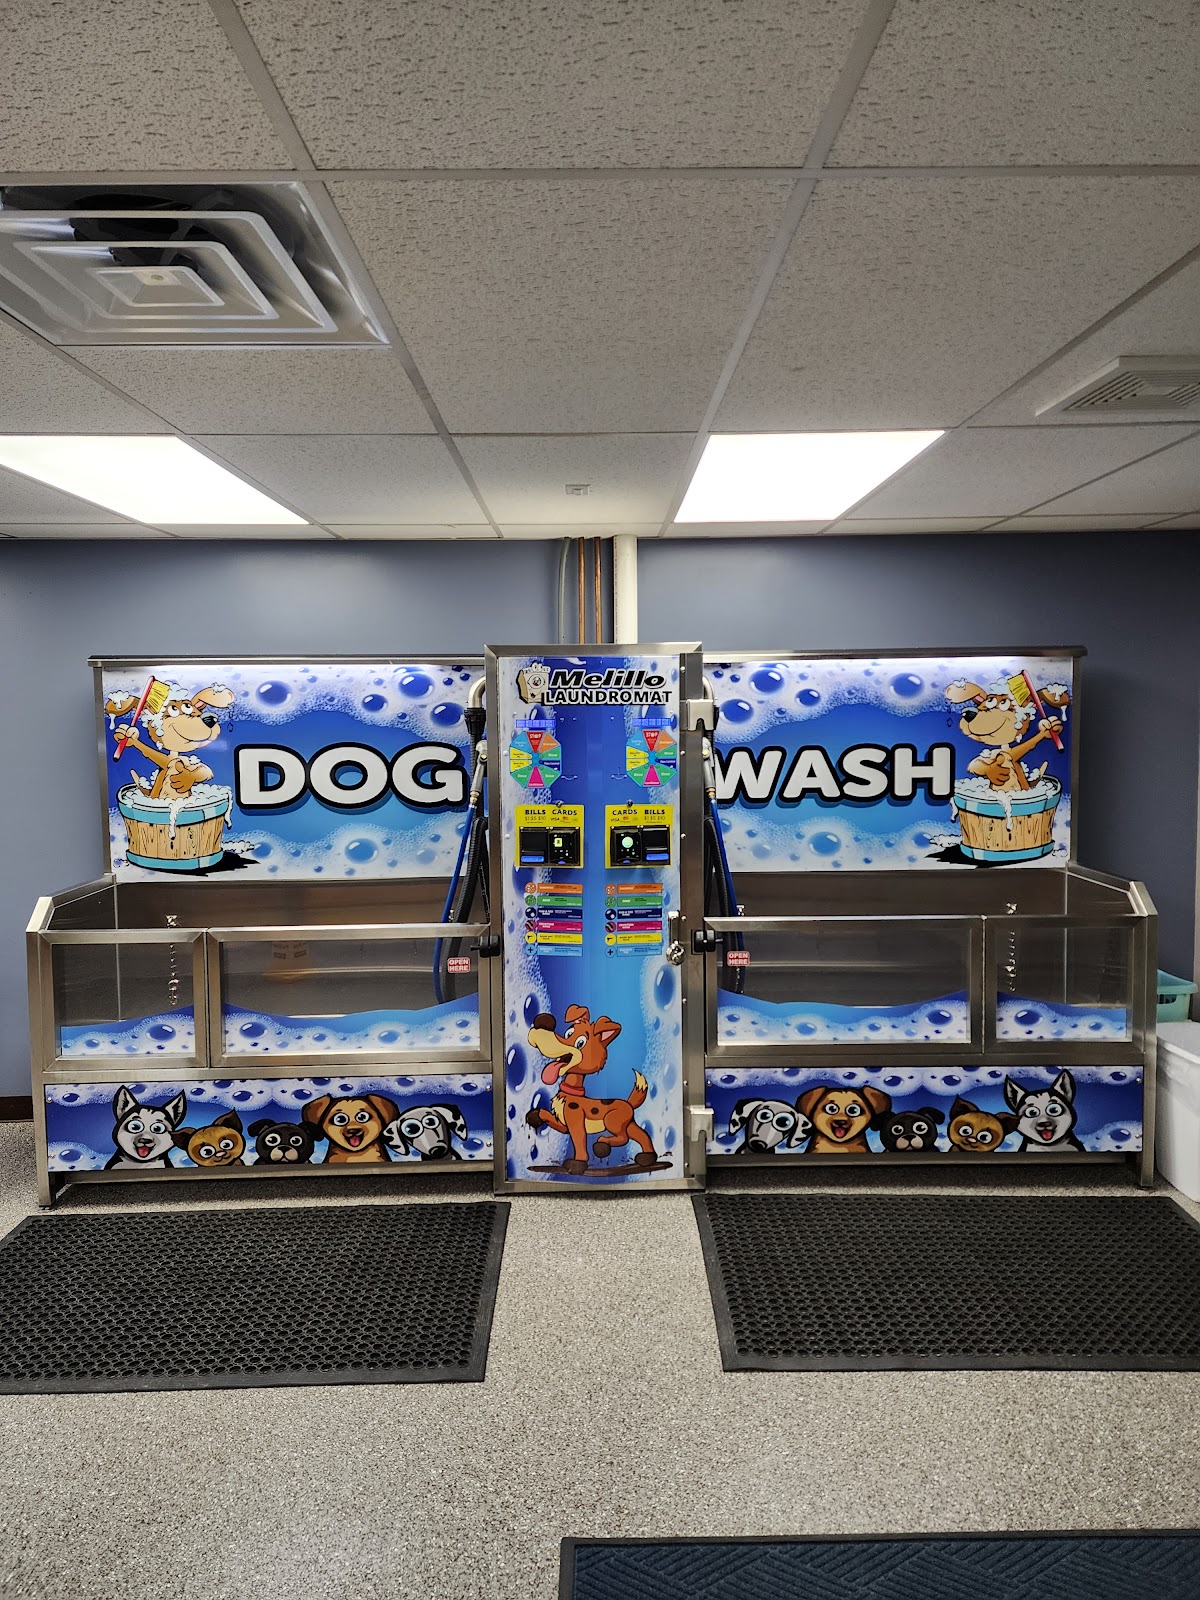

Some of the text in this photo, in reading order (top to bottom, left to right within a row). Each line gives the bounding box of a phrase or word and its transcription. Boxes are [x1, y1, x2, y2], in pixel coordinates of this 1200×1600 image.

[543, 690, 672, 704] LAUNDROMAT
[550, 669, 666, 689] Melillo
[235, 742, 467, 809] DOG
[714, 742, 955, 802] WASH
